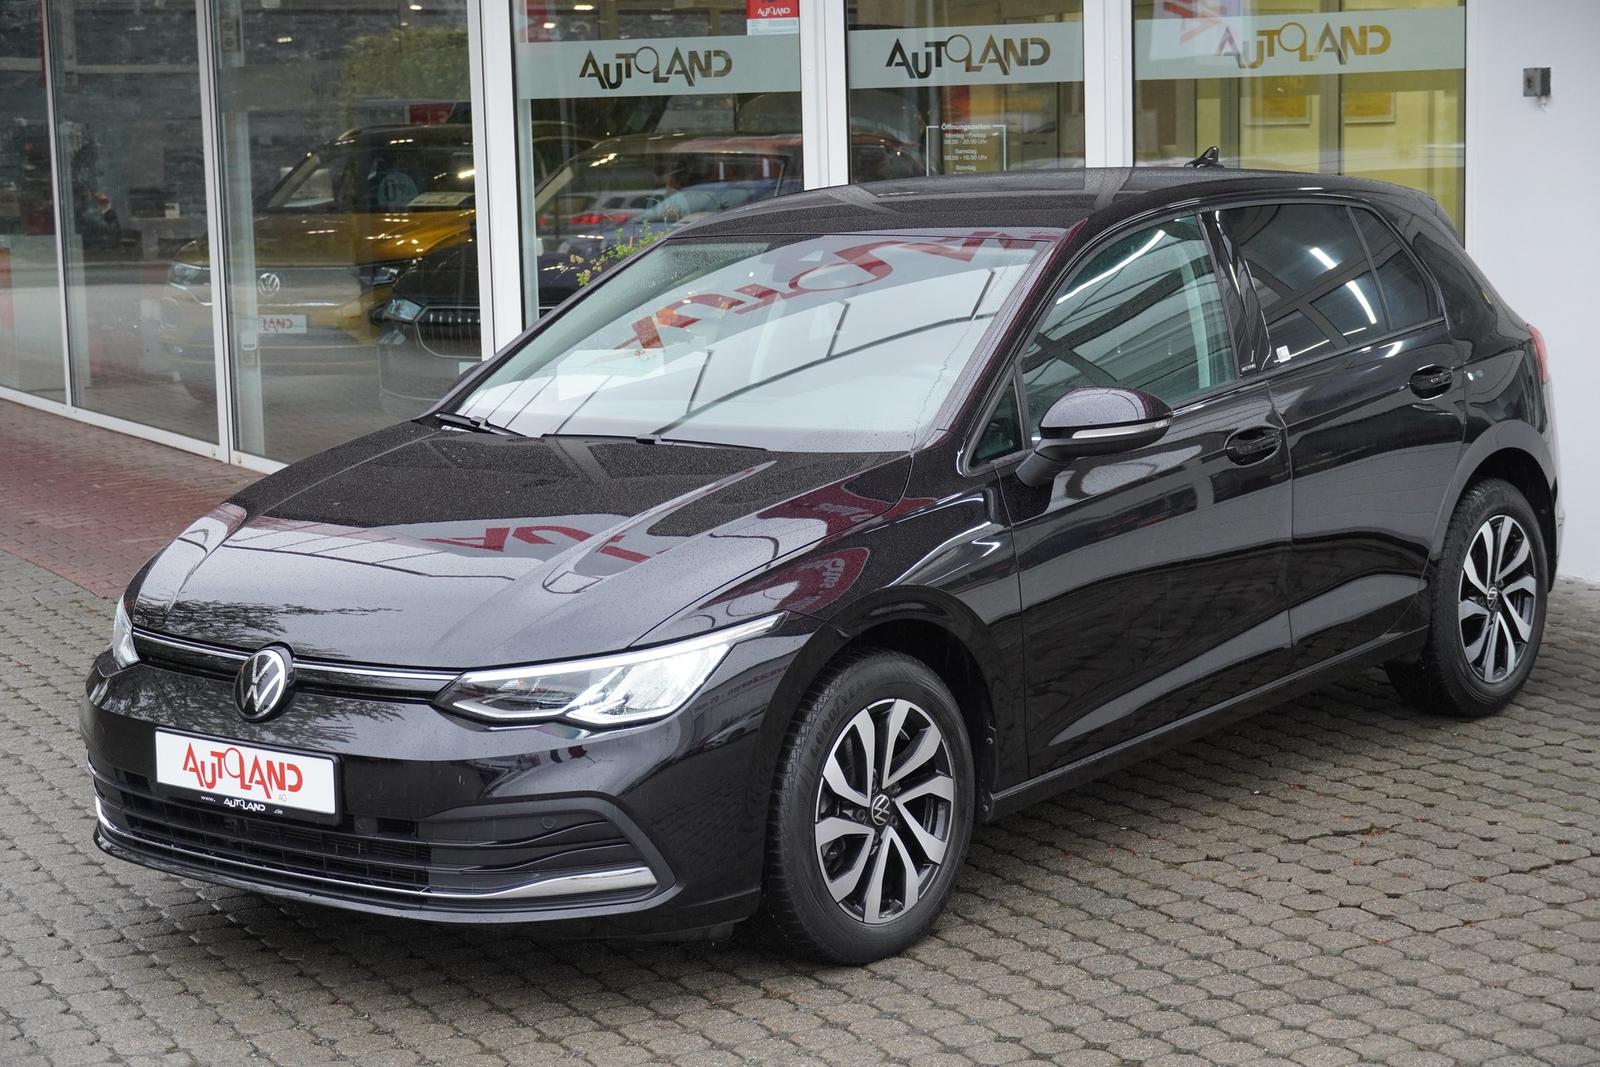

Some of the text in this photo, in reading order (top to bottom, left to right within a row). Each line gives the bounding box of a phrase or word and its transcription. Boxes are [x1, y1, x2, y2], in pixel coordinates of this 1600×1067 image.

[579, 46, 733, 90] AUTOLAND
[885, 33, 1052, 79] AUTOLAND
[1216, 21, 1392, 69] AUTOLAND
[182, 742, 304, 800] AUTOLAND
